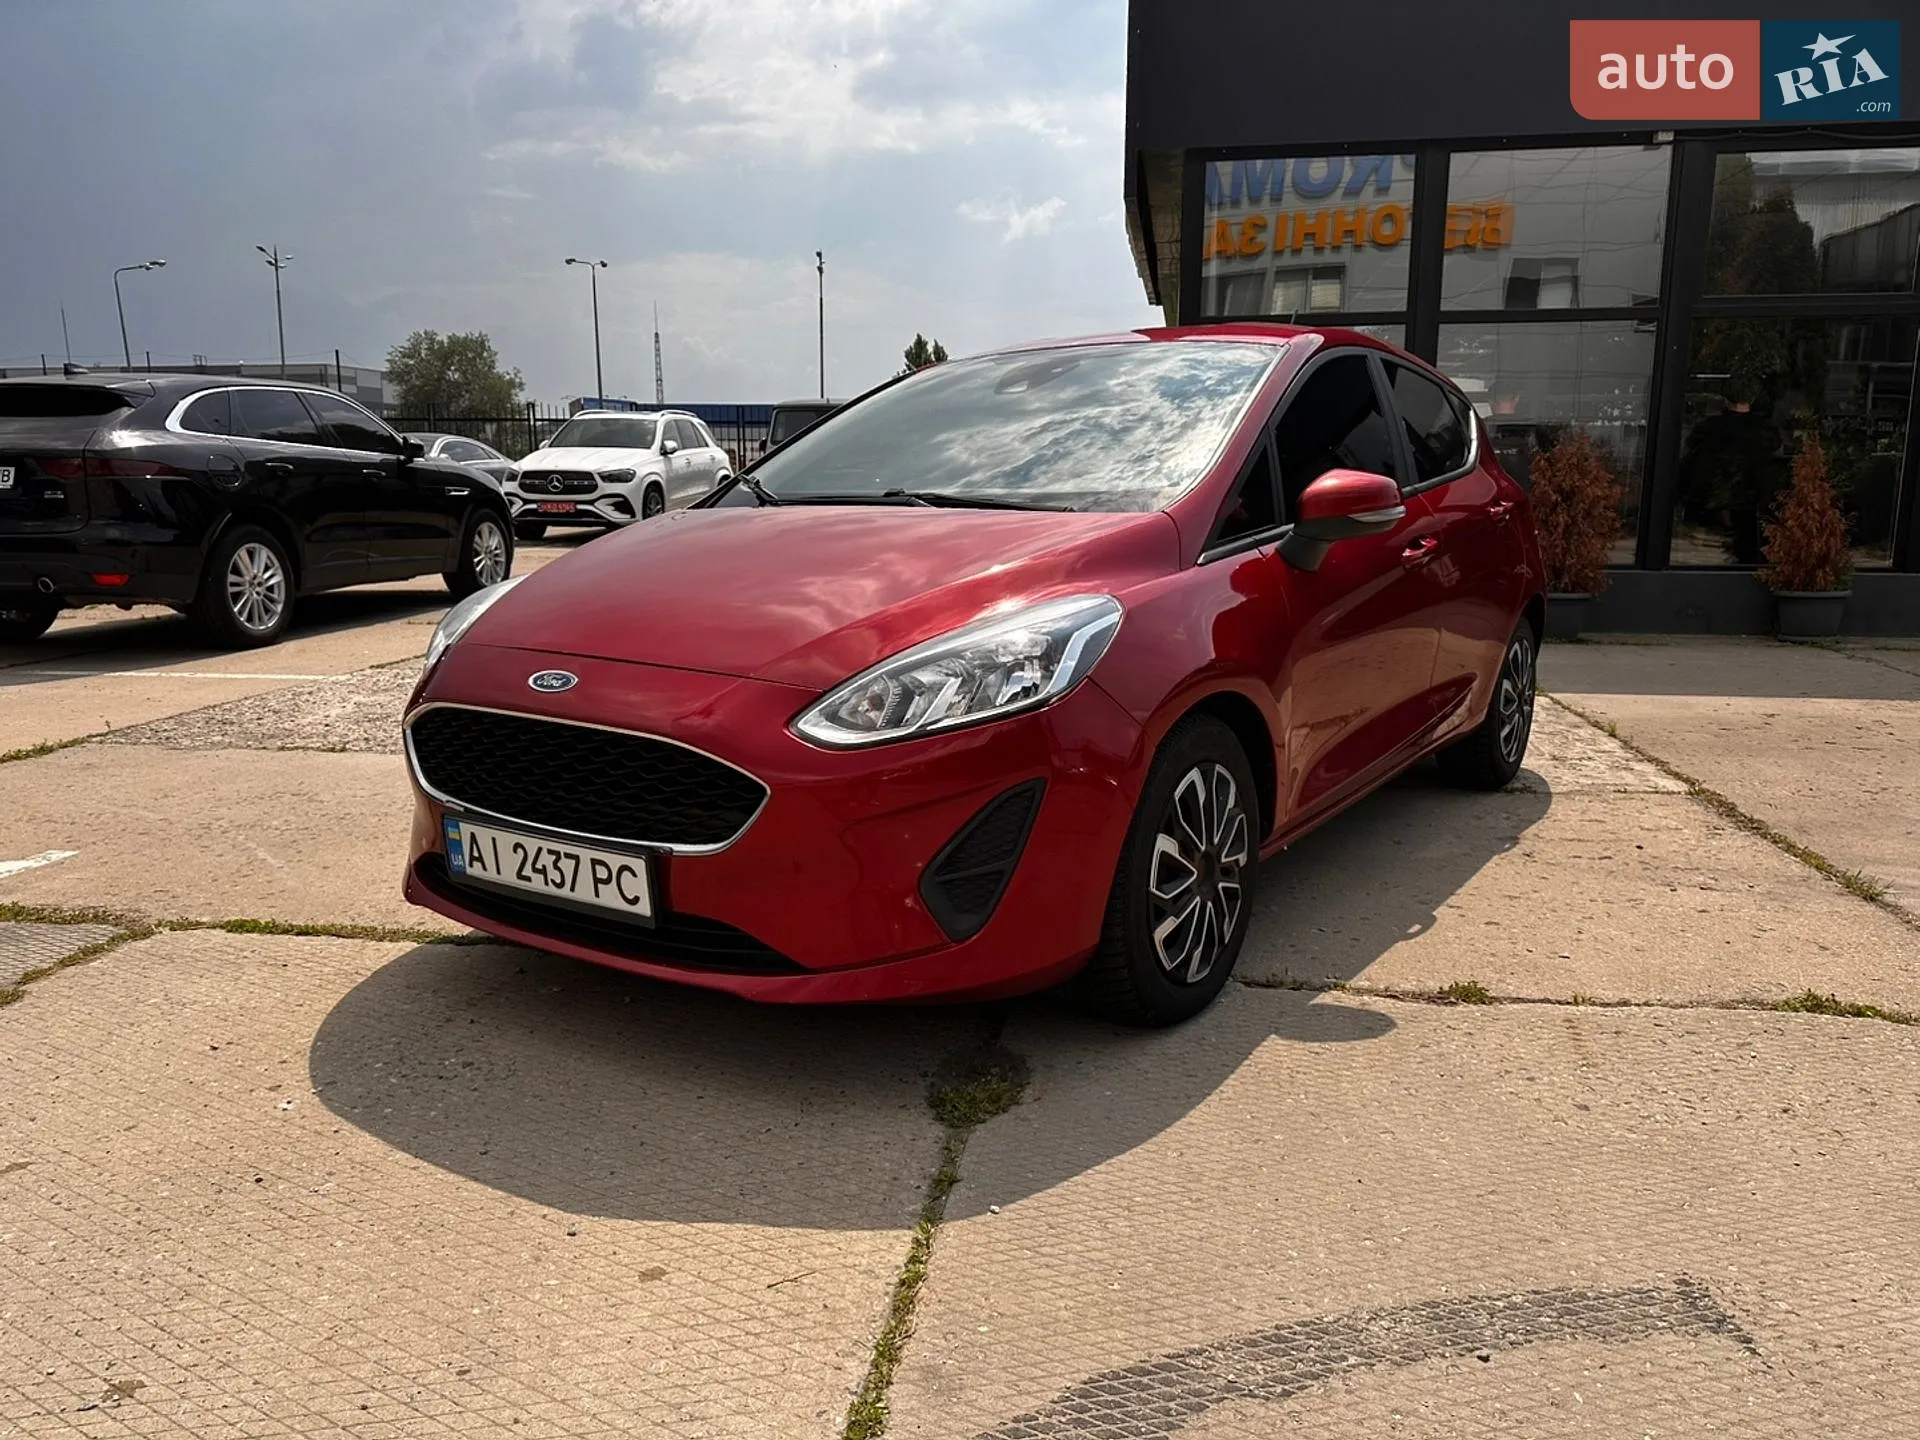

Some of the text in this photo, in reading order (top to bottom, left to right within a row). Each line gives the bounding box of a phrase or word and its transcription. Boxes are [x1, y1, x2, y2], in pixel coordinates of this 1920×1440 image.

[452, 854, 465, 867] UA
[468, 831, 641, 906] AI 2437 PC
